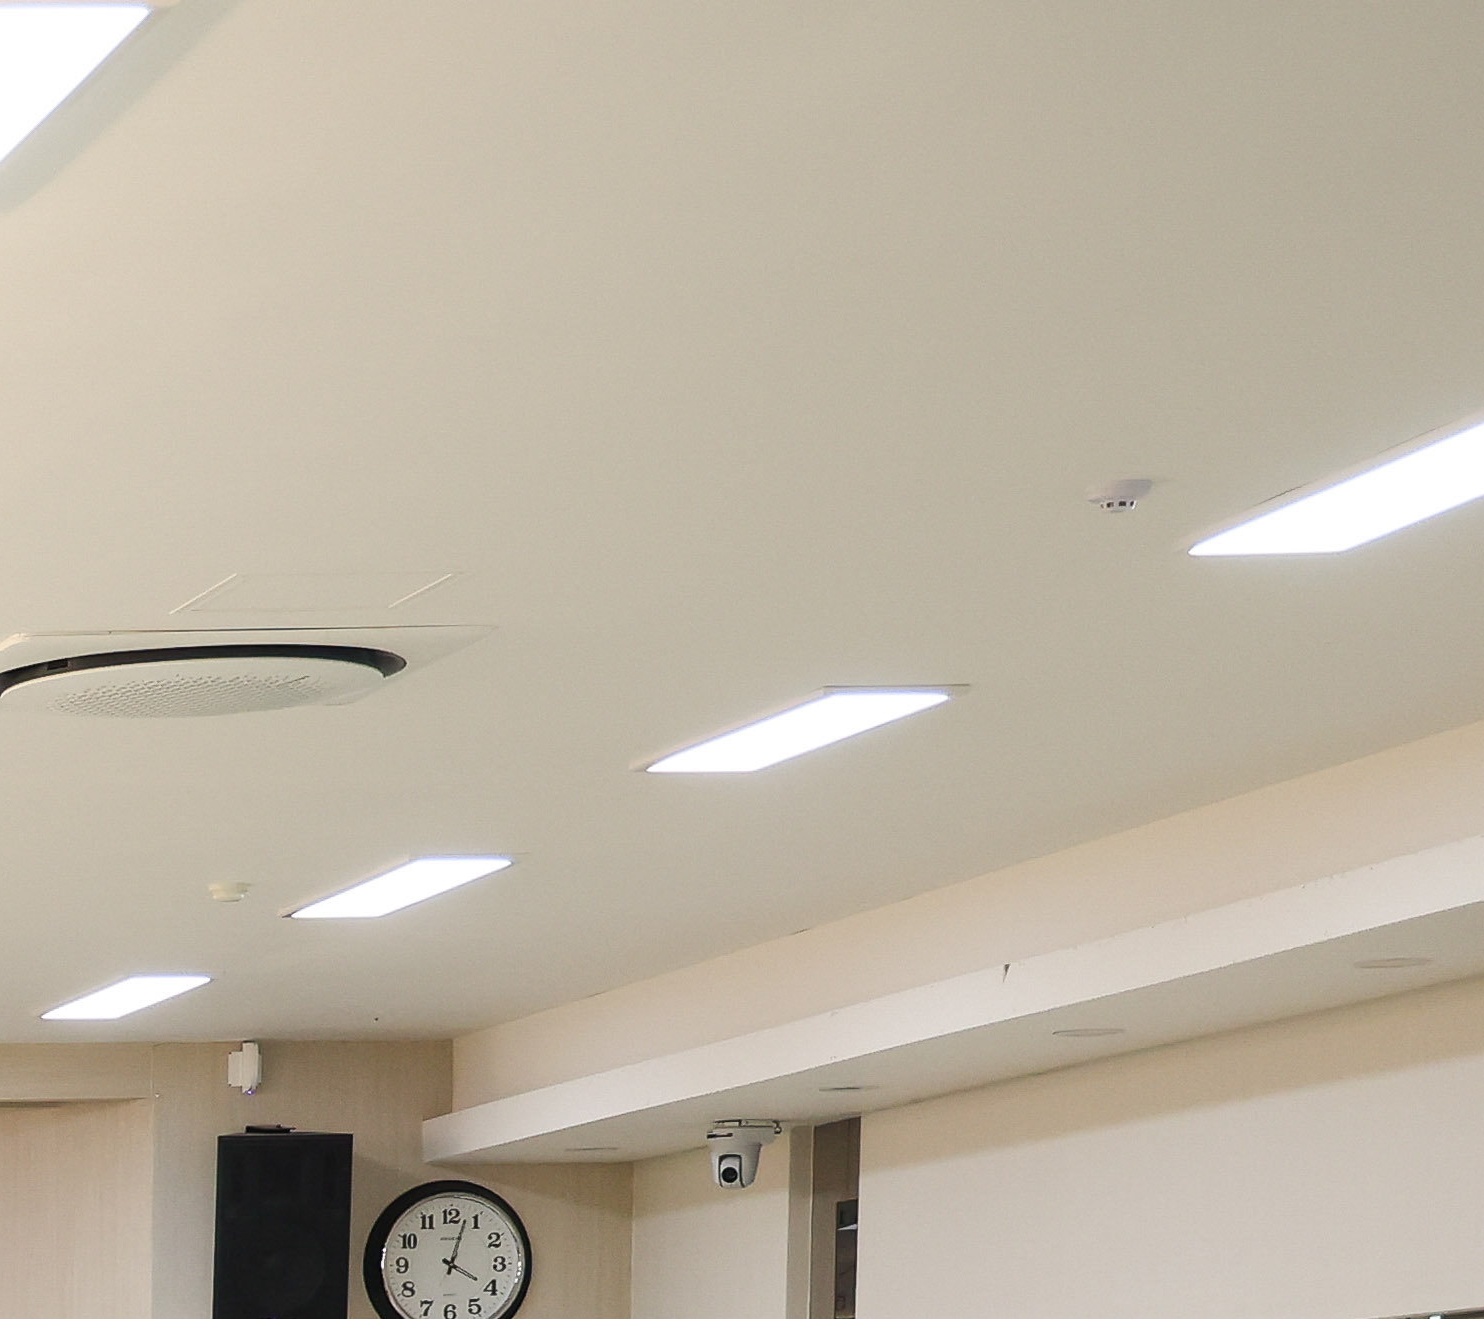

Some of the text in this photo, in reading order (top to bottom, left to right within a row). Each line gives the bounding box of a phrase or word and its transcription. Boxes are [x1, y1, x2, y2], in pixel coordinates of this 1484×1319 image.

[420, 1214, 435, 1230] 11
[442, 1208, 461, 1225] 12
[471, 1213, 481, 1229] 1
[401, 1233, 418, 1249] 10
[488, 1232, 502, 1248] 2
[395, 1257, 409, 1274] 9
[492, 1256, 506, 1272] 3
[401, 1281, 415, 1297] 8
[483, 1279, 498, 1296] 4
[420, 1300, 434, 1316] 7
[468, 1298, 482, 1315] 5
